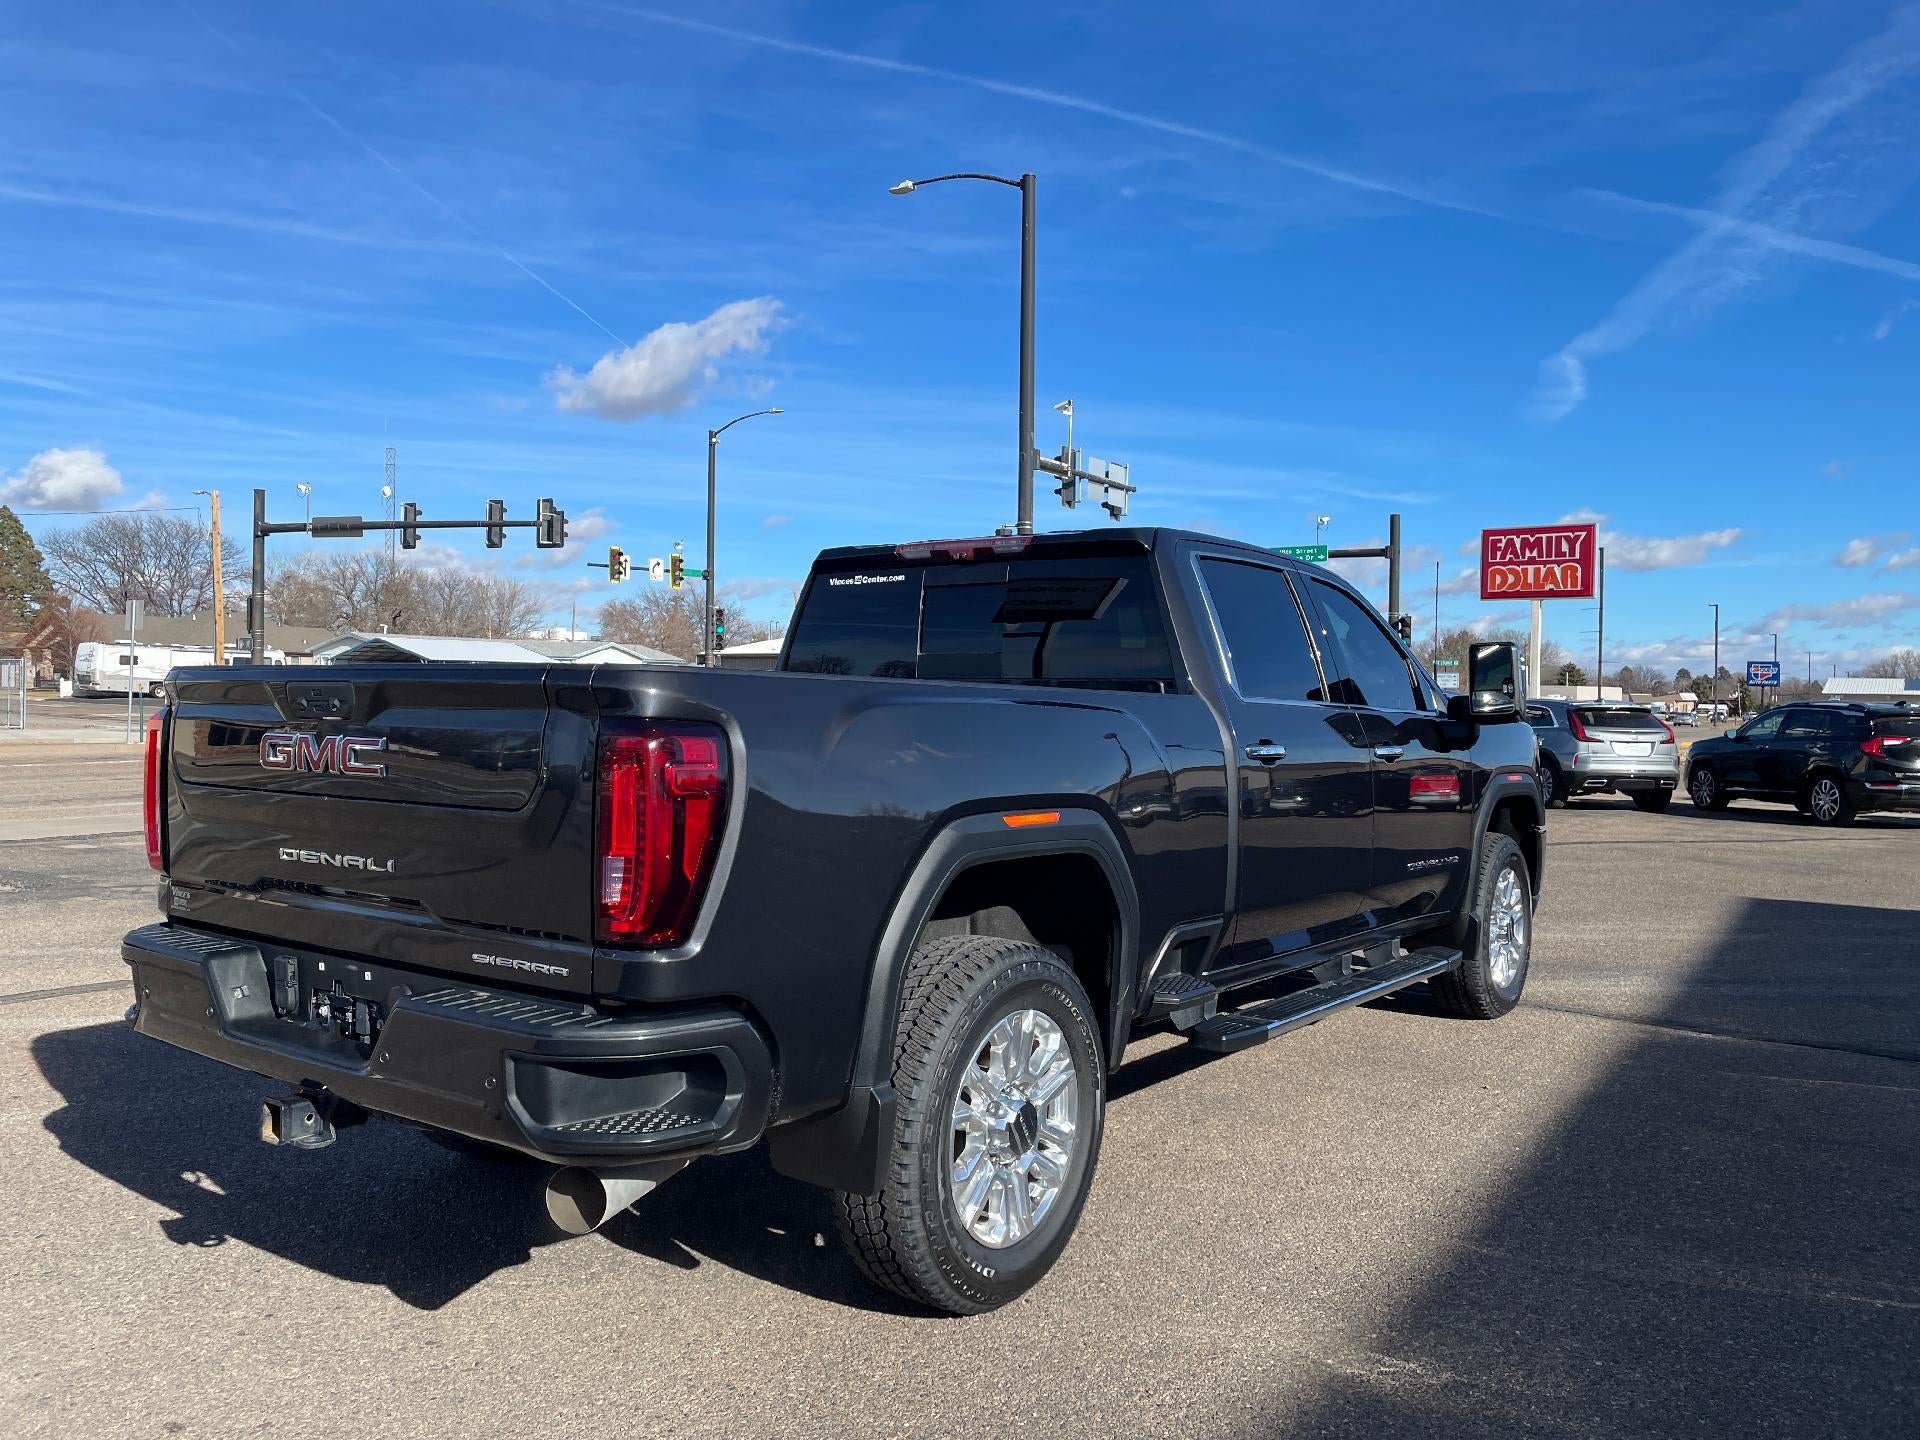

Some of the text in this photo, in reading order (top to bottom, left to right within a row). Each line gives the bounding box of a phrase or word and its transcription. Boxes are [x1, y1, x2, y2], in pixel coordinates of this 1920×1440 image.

[1488, 532, 1587, 562] FAMILY
[1487, 562, 1582, 592] DOLLAR
[260, 732, 389, 778] GMC
[279, 847, 395, 873] DENALI
[471, 953, 570, 977] SIERRA
